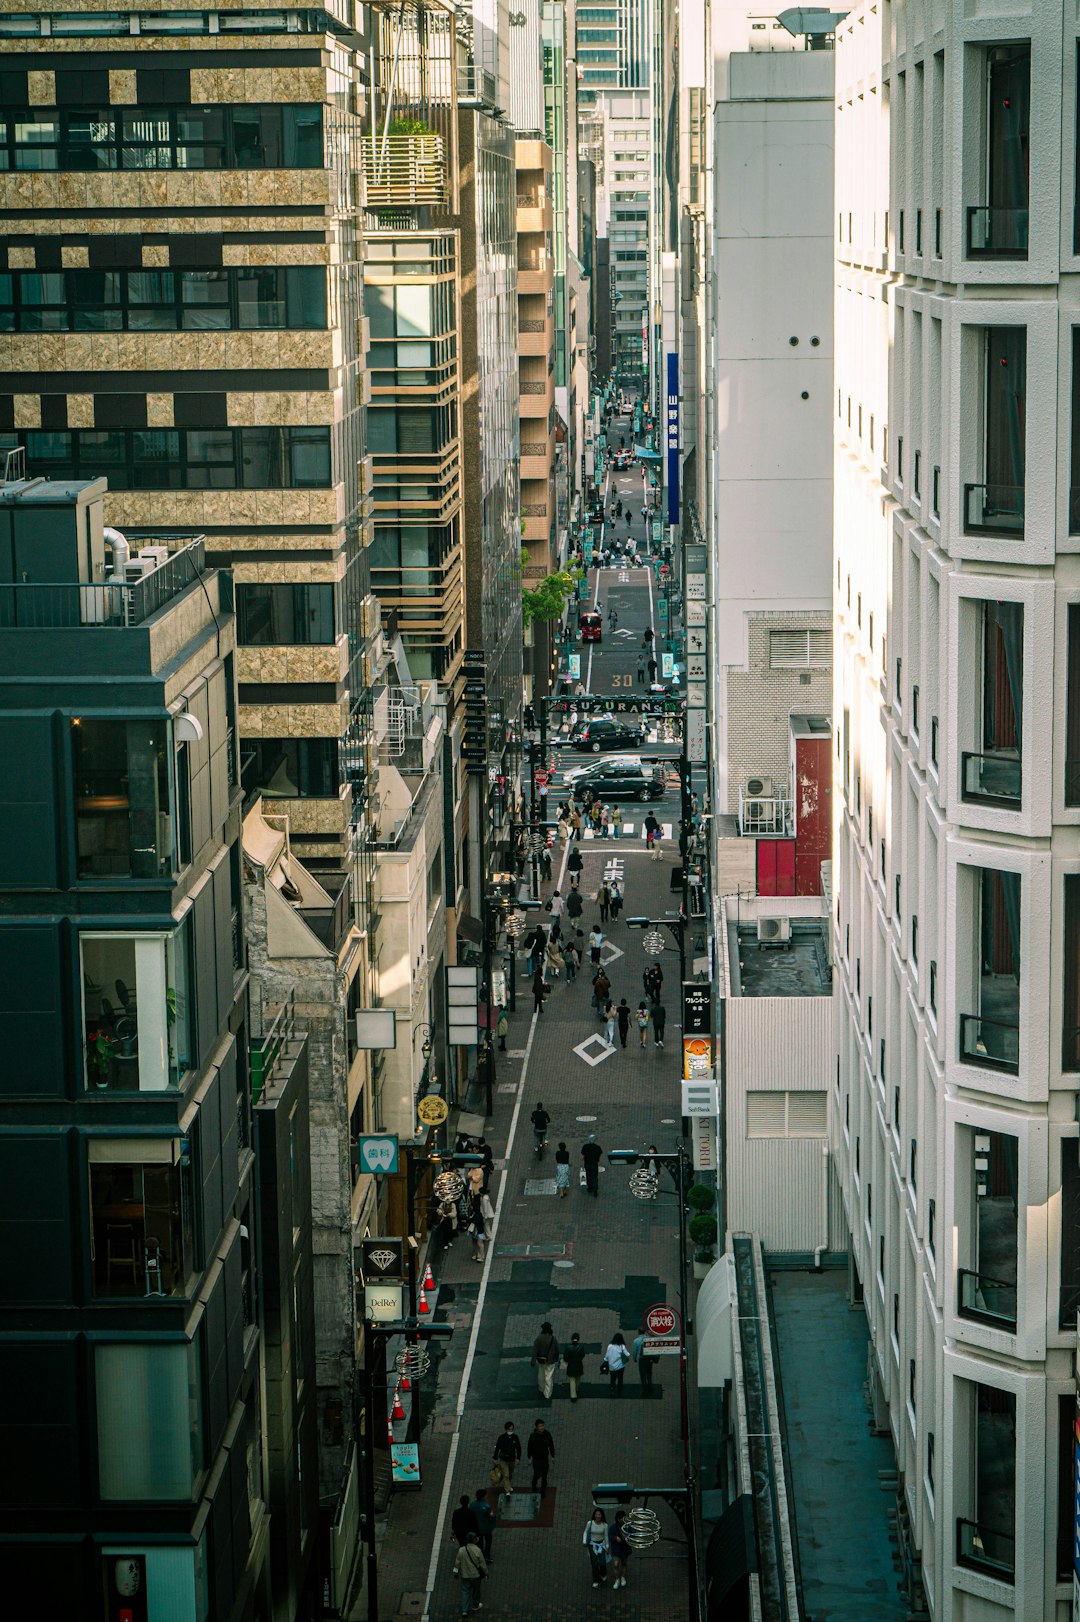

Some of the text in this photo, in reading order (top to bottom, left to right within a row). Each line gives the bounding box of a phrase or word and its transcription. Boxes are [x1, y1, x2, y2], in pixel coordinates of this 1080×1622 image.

[612, 674, 633, 687] 30
[569, 701, 651, 713] SUZURAN
[368, 1148, 390, 1159] 歯科
[650, 1316, 673, 1327] 消火栓
